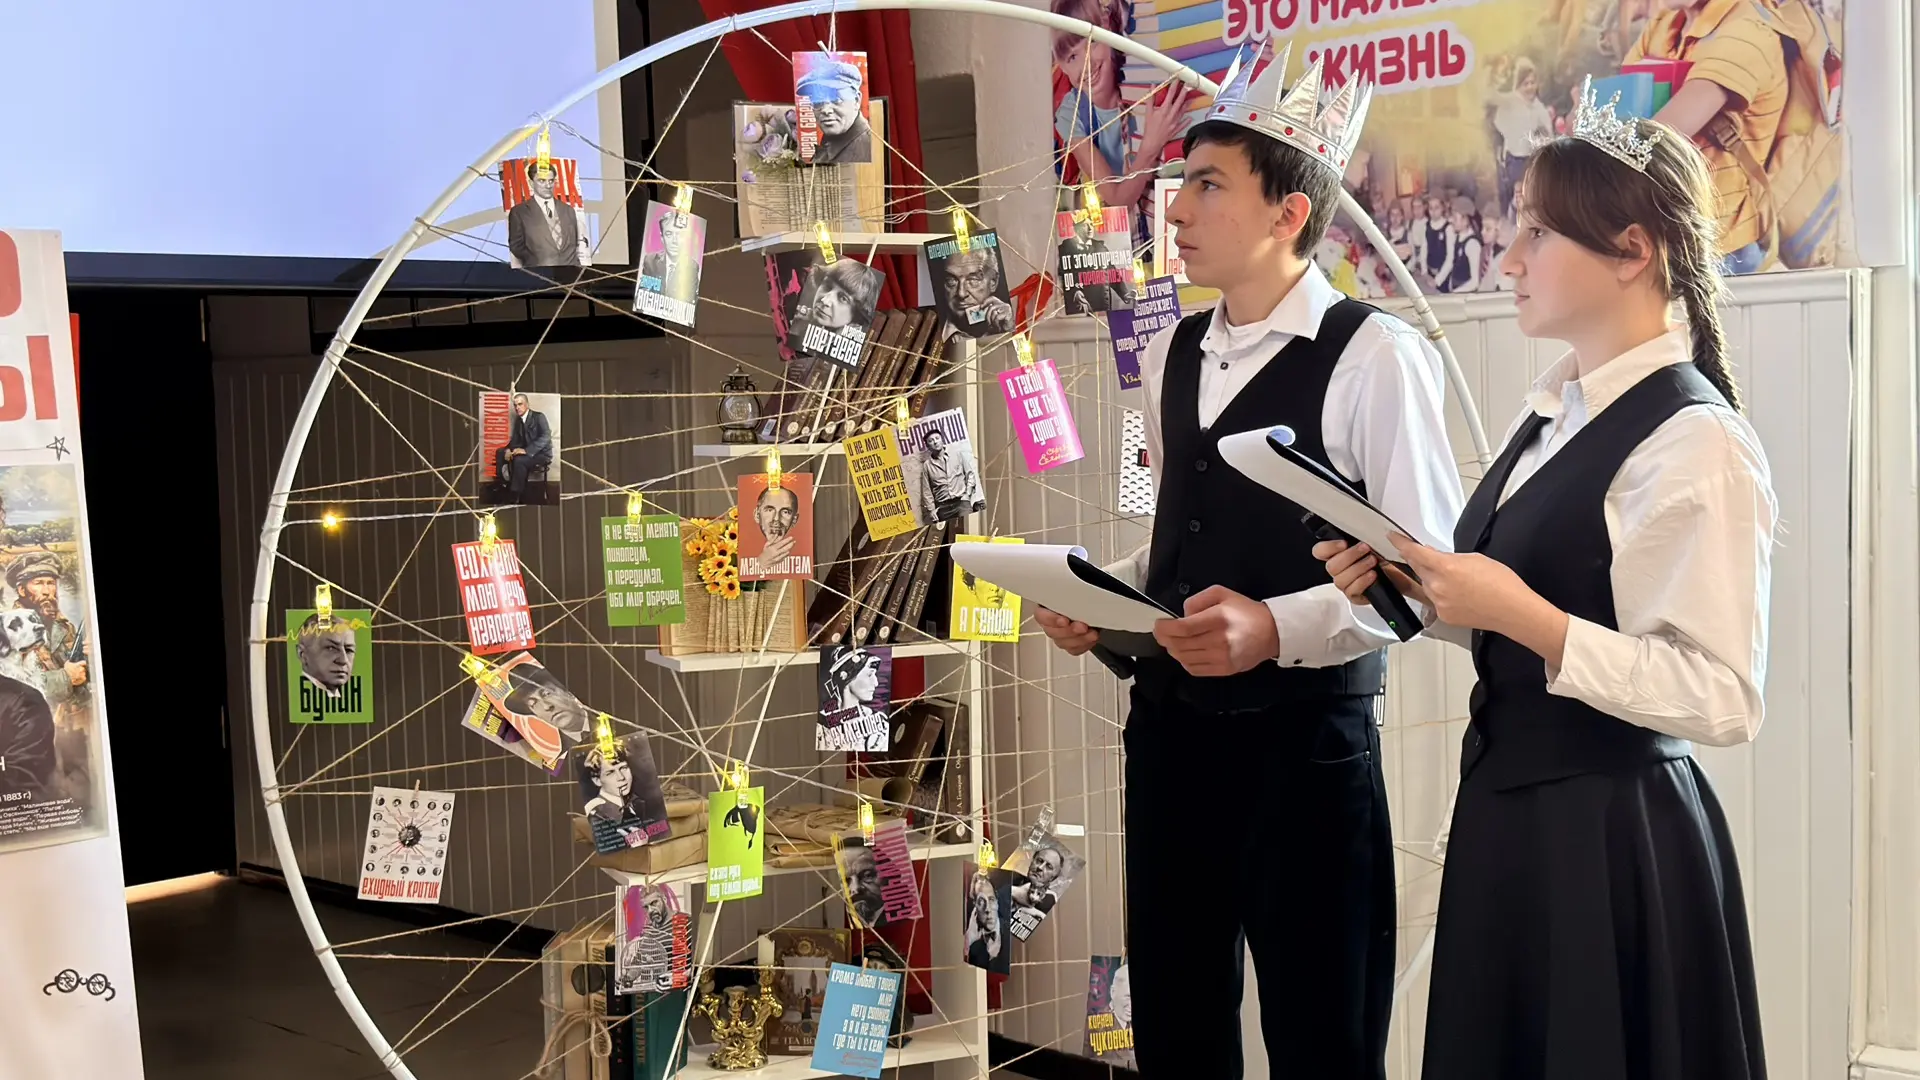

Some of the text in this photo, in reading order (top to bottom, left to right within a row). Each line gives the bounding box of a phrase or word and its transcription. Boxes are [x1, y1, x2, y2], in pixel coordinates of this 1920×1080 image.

[1227, 0, 1299, 39] ЭТО
[1309, 29, 1466, 90] ЖИЗНЬ
[740, 556, 812, 579] МАНЬШТАМ
[2, 792, 22, 801] 1883
